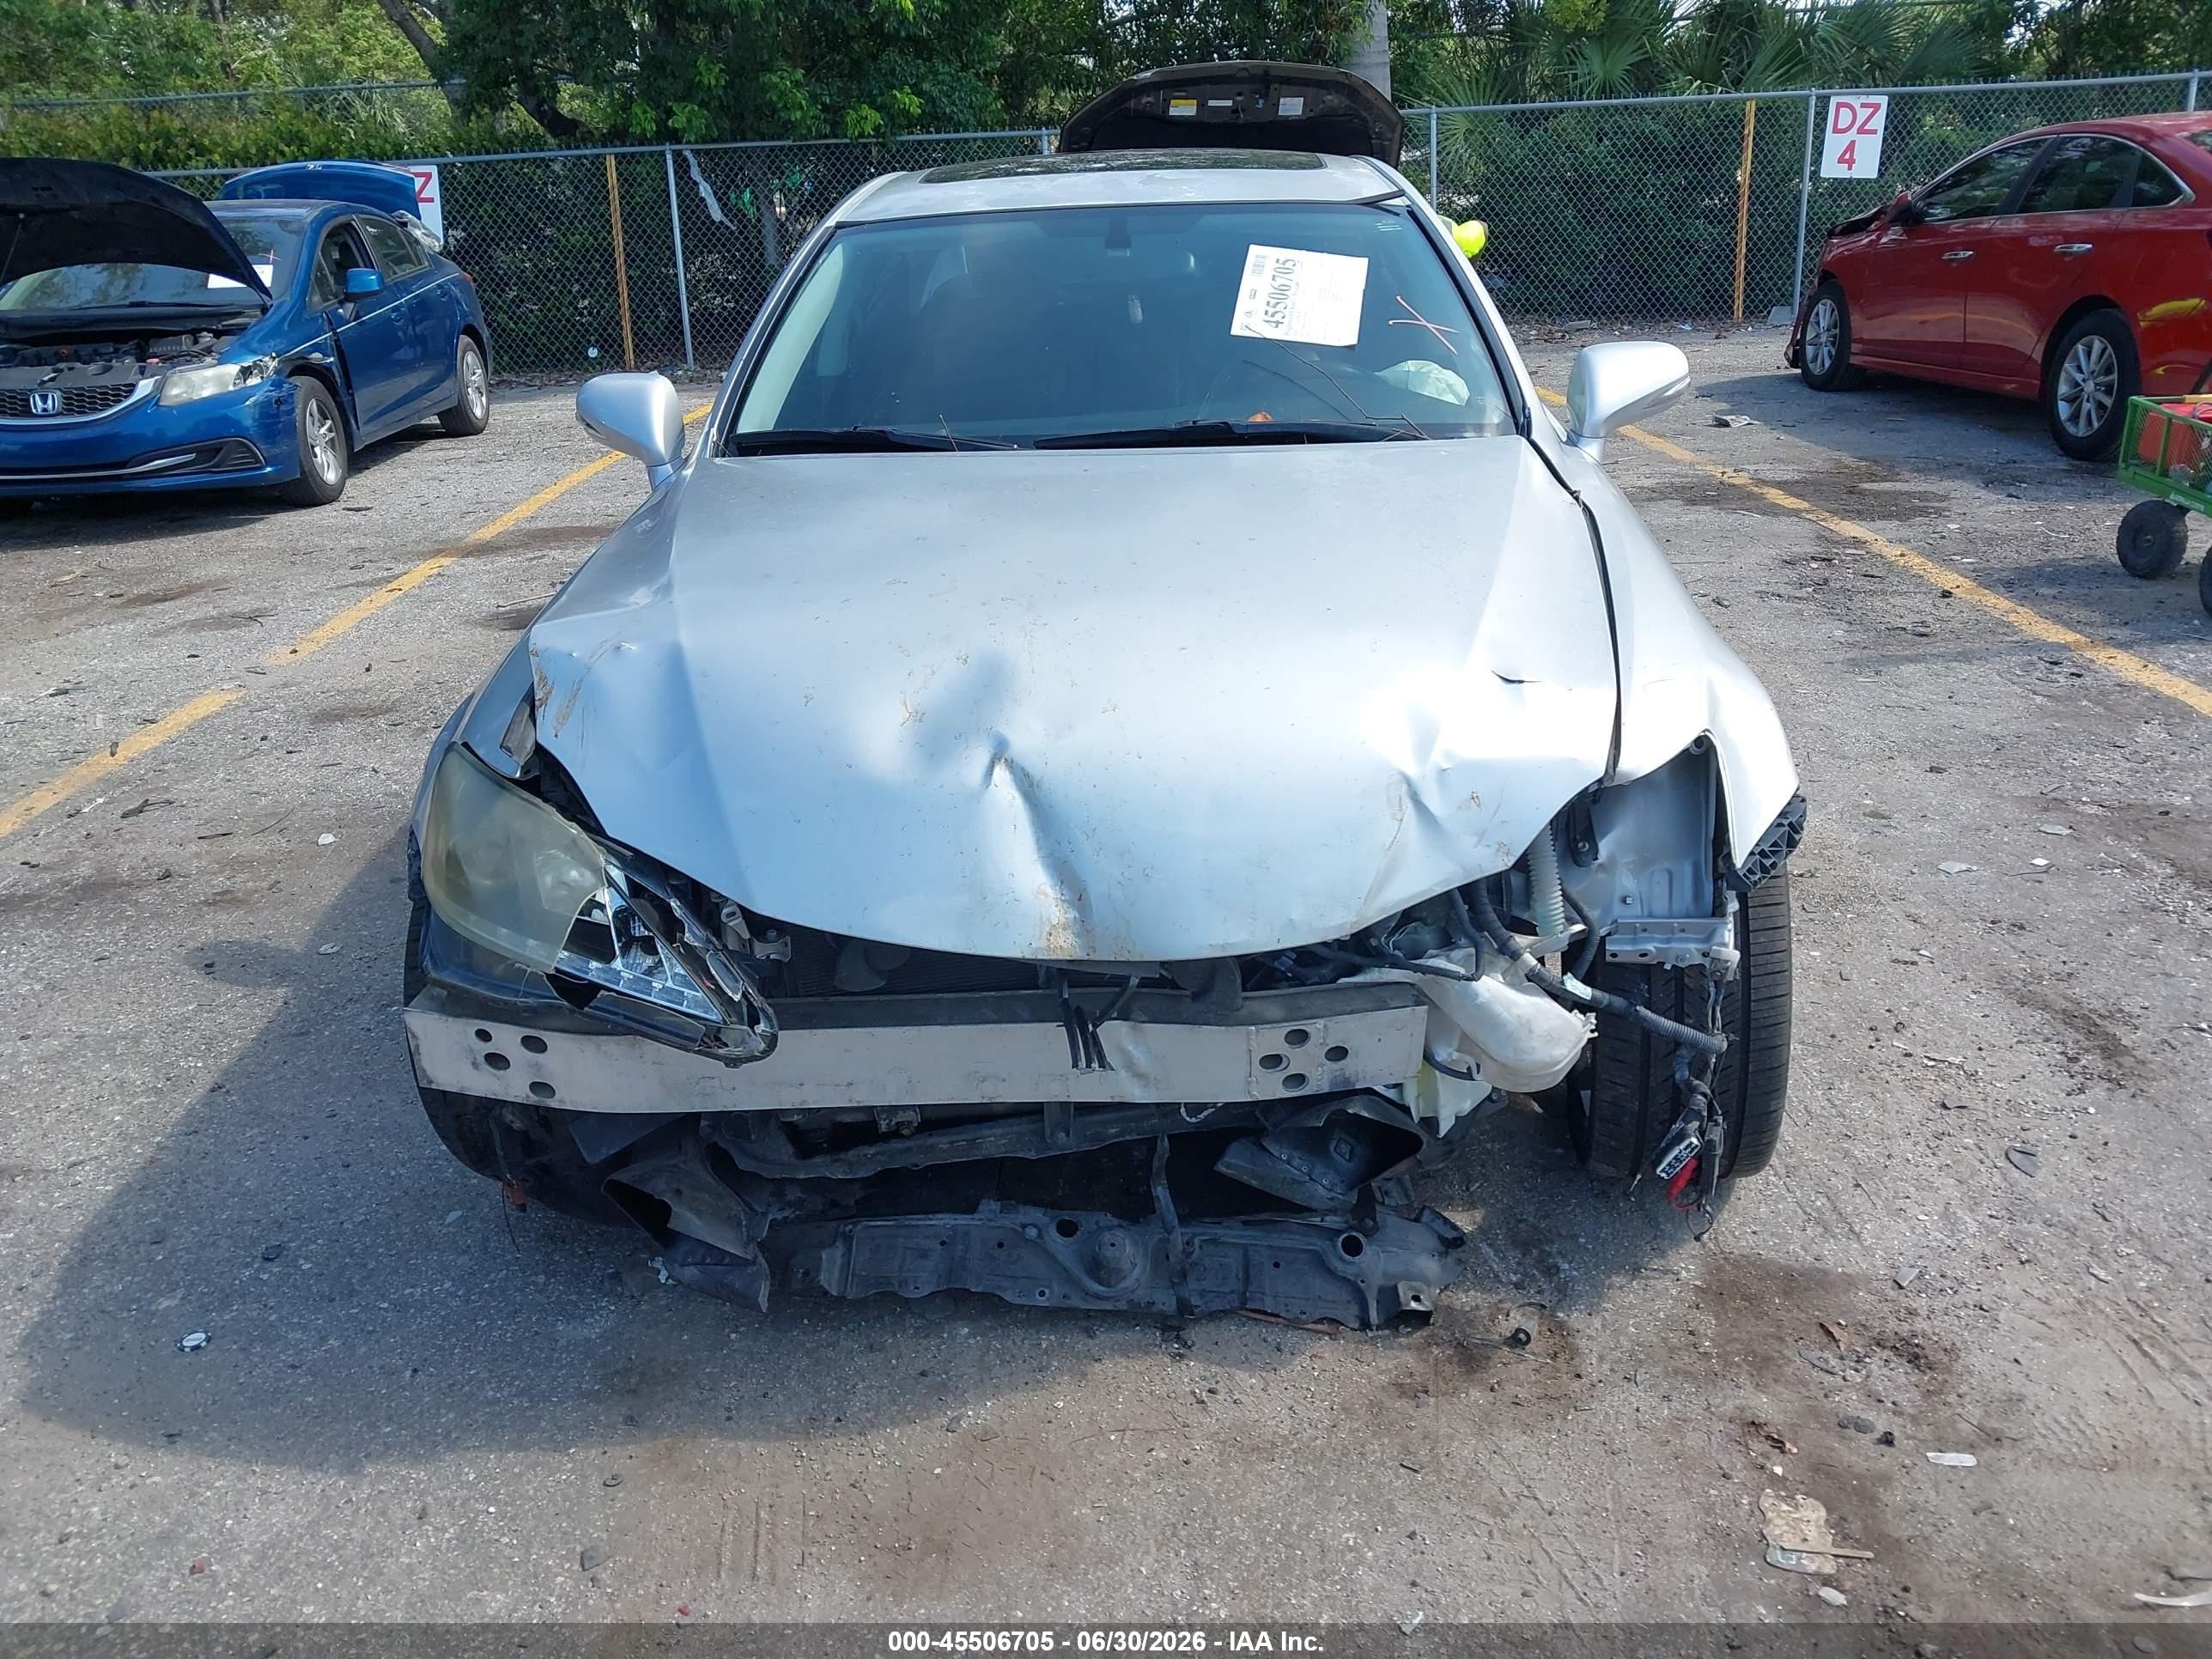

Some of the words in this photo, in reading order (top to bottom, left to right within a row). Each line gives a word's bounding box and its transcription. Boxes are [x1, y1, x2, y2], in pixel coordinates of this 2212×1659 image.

[1832, 101, 1882, 135] DZ
[1837, 139, 1856, 171] 4
[413, 172, 434, 203] Z
[1262, 258, 1297, 329] 45506705
